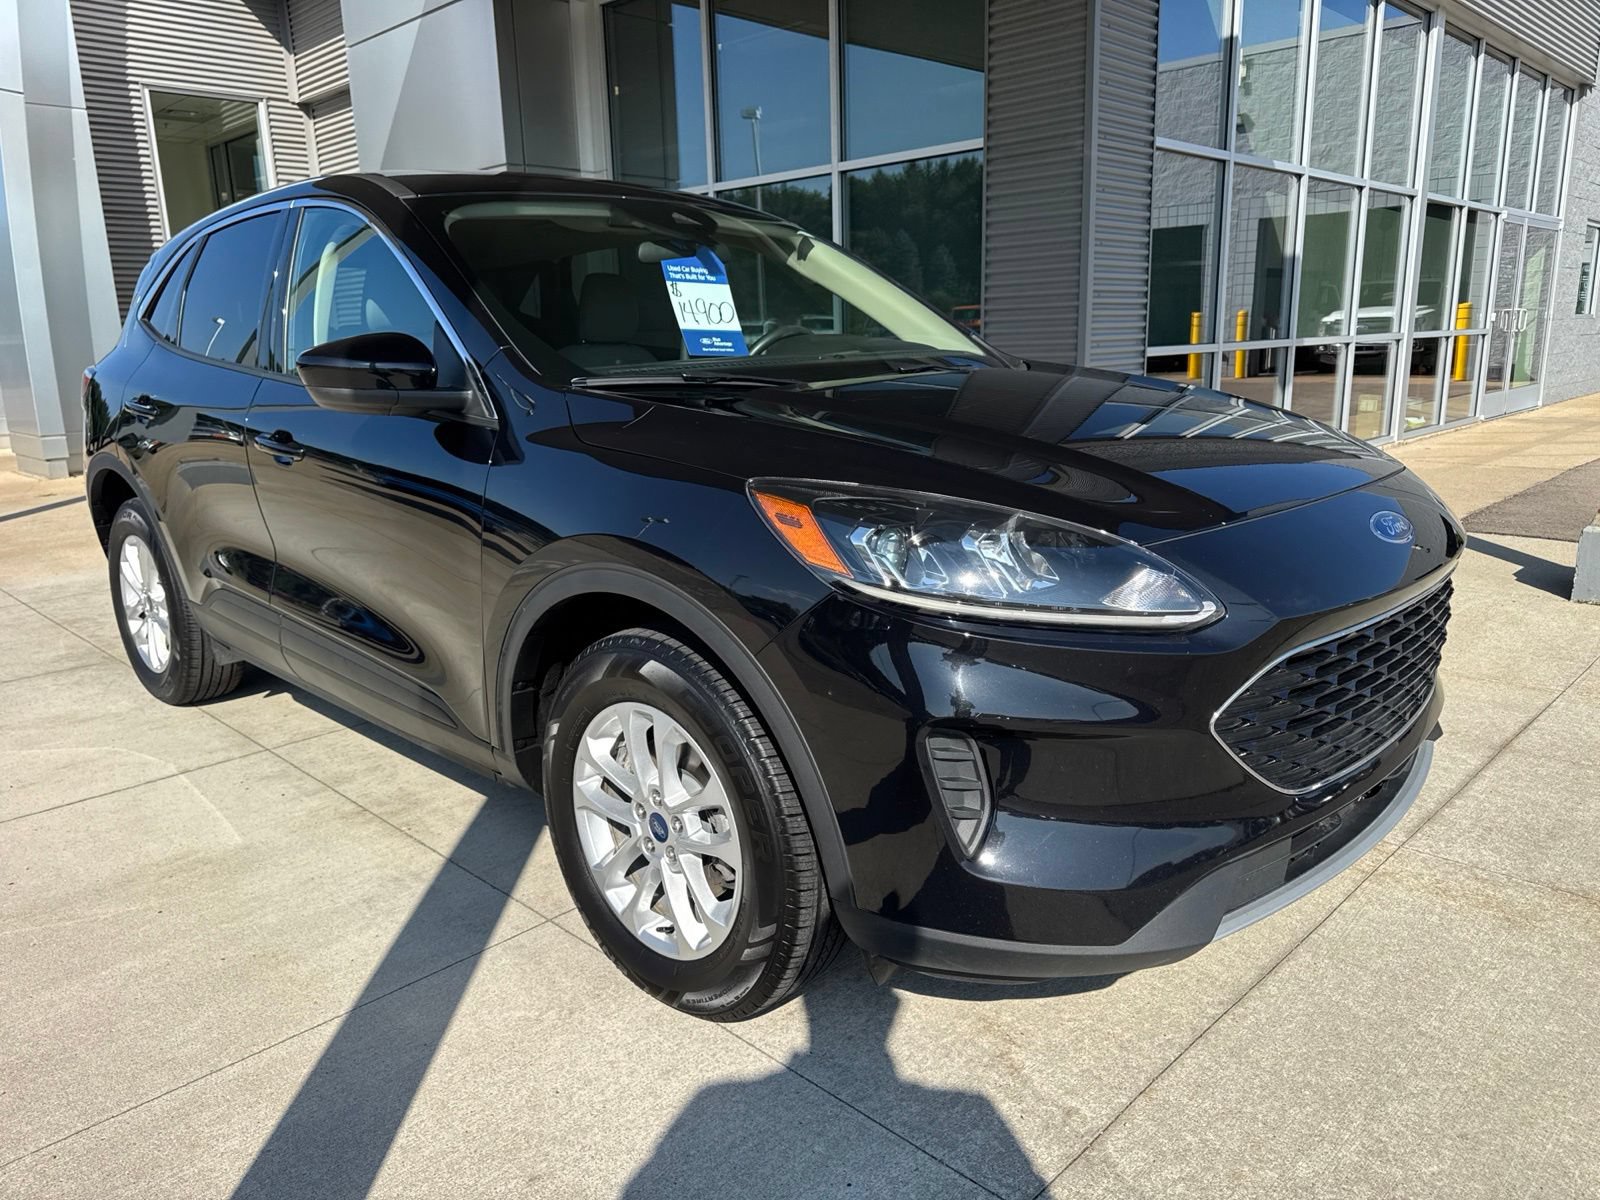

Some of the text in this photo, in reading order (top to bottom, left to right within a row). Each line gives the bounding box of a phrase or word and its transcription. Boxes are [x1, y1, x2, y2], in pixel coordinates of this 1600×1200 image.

[667, 264, 680, 272] Used
[691, 266, 709, 275] Buying
[669, 272, 685, 280] That's
[671, 281, 682, 297] $
